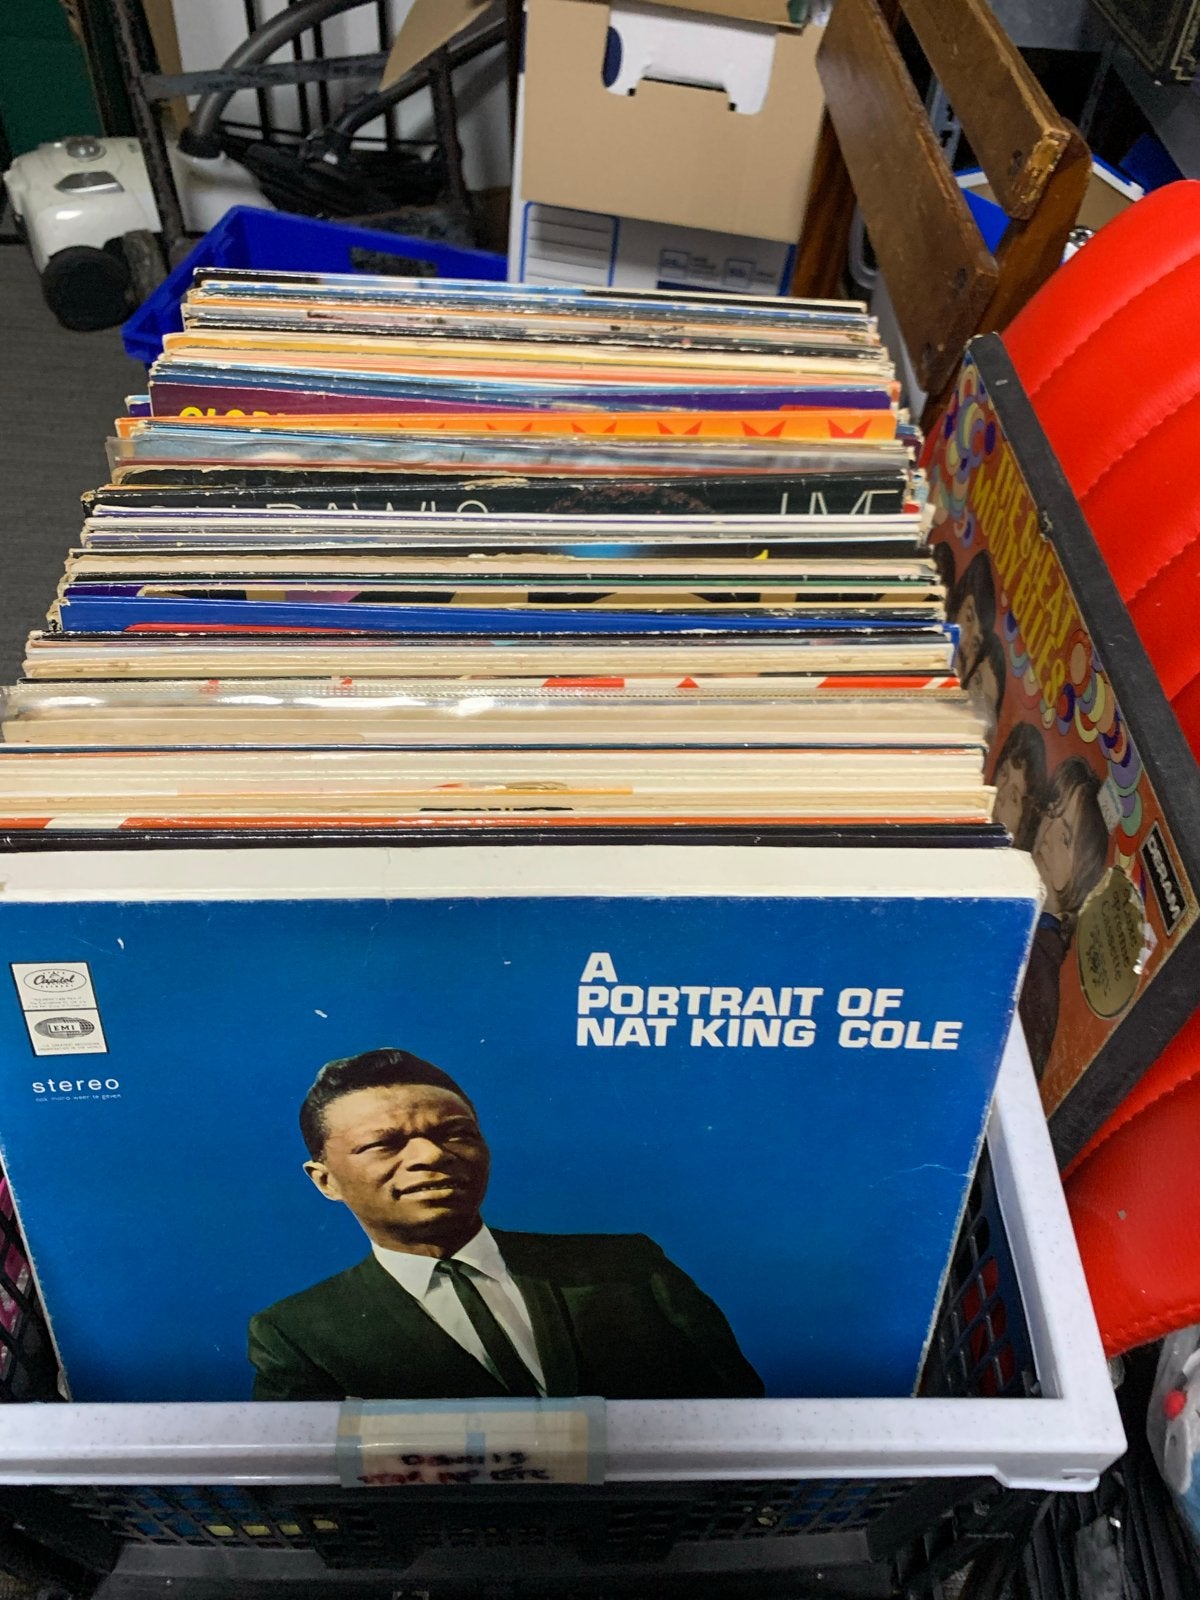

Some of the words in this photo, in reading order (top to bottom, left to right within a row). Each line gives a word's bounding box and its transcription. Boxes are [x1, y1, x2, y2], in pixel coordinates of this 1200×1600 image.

[995, 442, 1026, 540] THE
[1021, 511, 1077, 648] GREAT
[971, 463, 1022, 590] MOODY
[1012, 570, 1065, 708] BLUES
[1147, 834, 1181, 920] DERAM
[33, 972, 76, 986] Capitol
[580, 952, 618, 983] A
[577, 985, 824, 1016] PORTRAIT
[837, 988, 904, 1017] OF
[53, 1023, 76, 1032] EMI
[576, 1017, 677, 1047] NAT
[690, 1018, 816, 1048] KING
[838, 1020, 963, 1050] COLE
[32, 1078, 120, 1094] stereo
